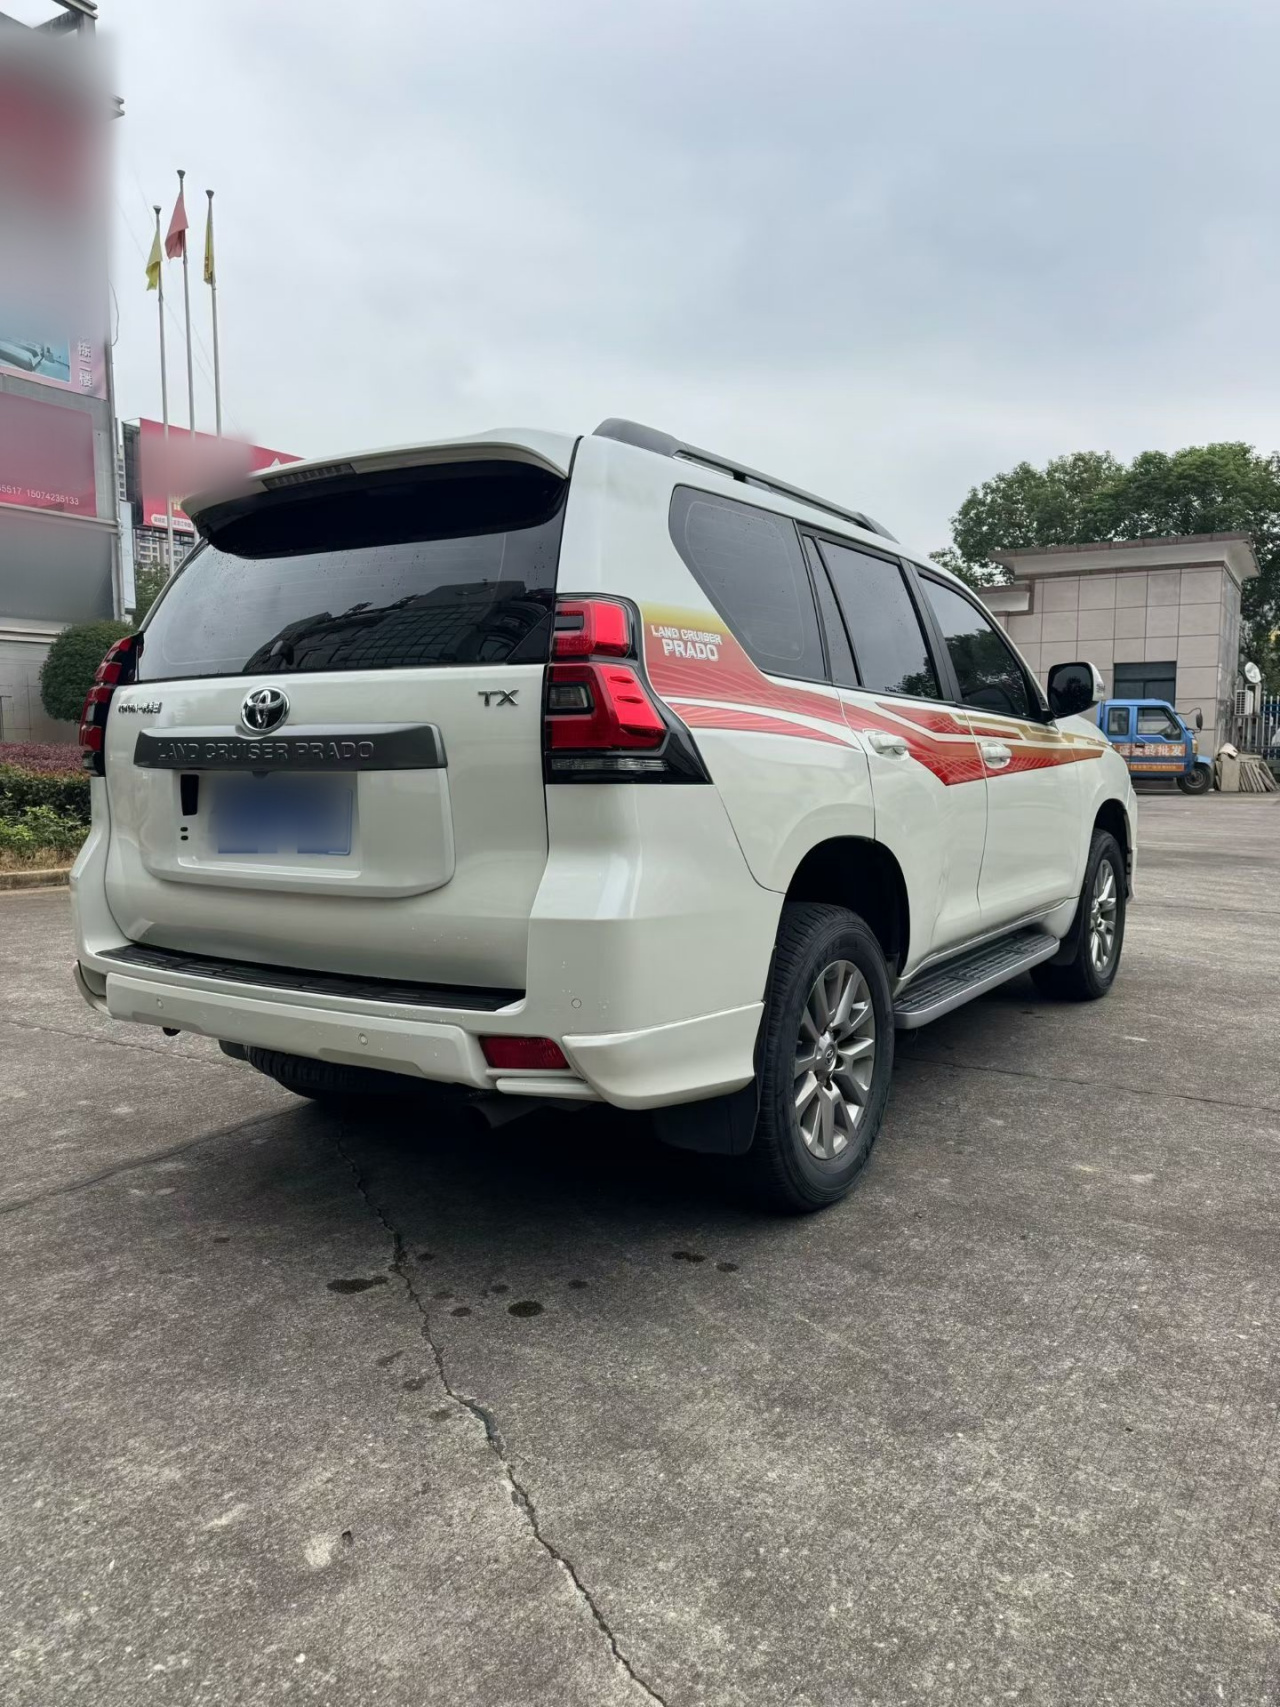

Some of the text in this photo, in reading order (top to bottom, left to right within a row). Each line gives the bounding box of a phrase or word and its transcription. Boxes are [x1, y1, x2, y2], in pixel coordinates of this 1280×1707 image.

[26, 489, 79, 506] 15074235133
[651, 624, 723, 645] LAND CRUISER
[662, 638, 719, 662] PRADO
[478, 689, 520, 707] TX
[158, 741, 375, 761] LAND CRUISER PRADO
